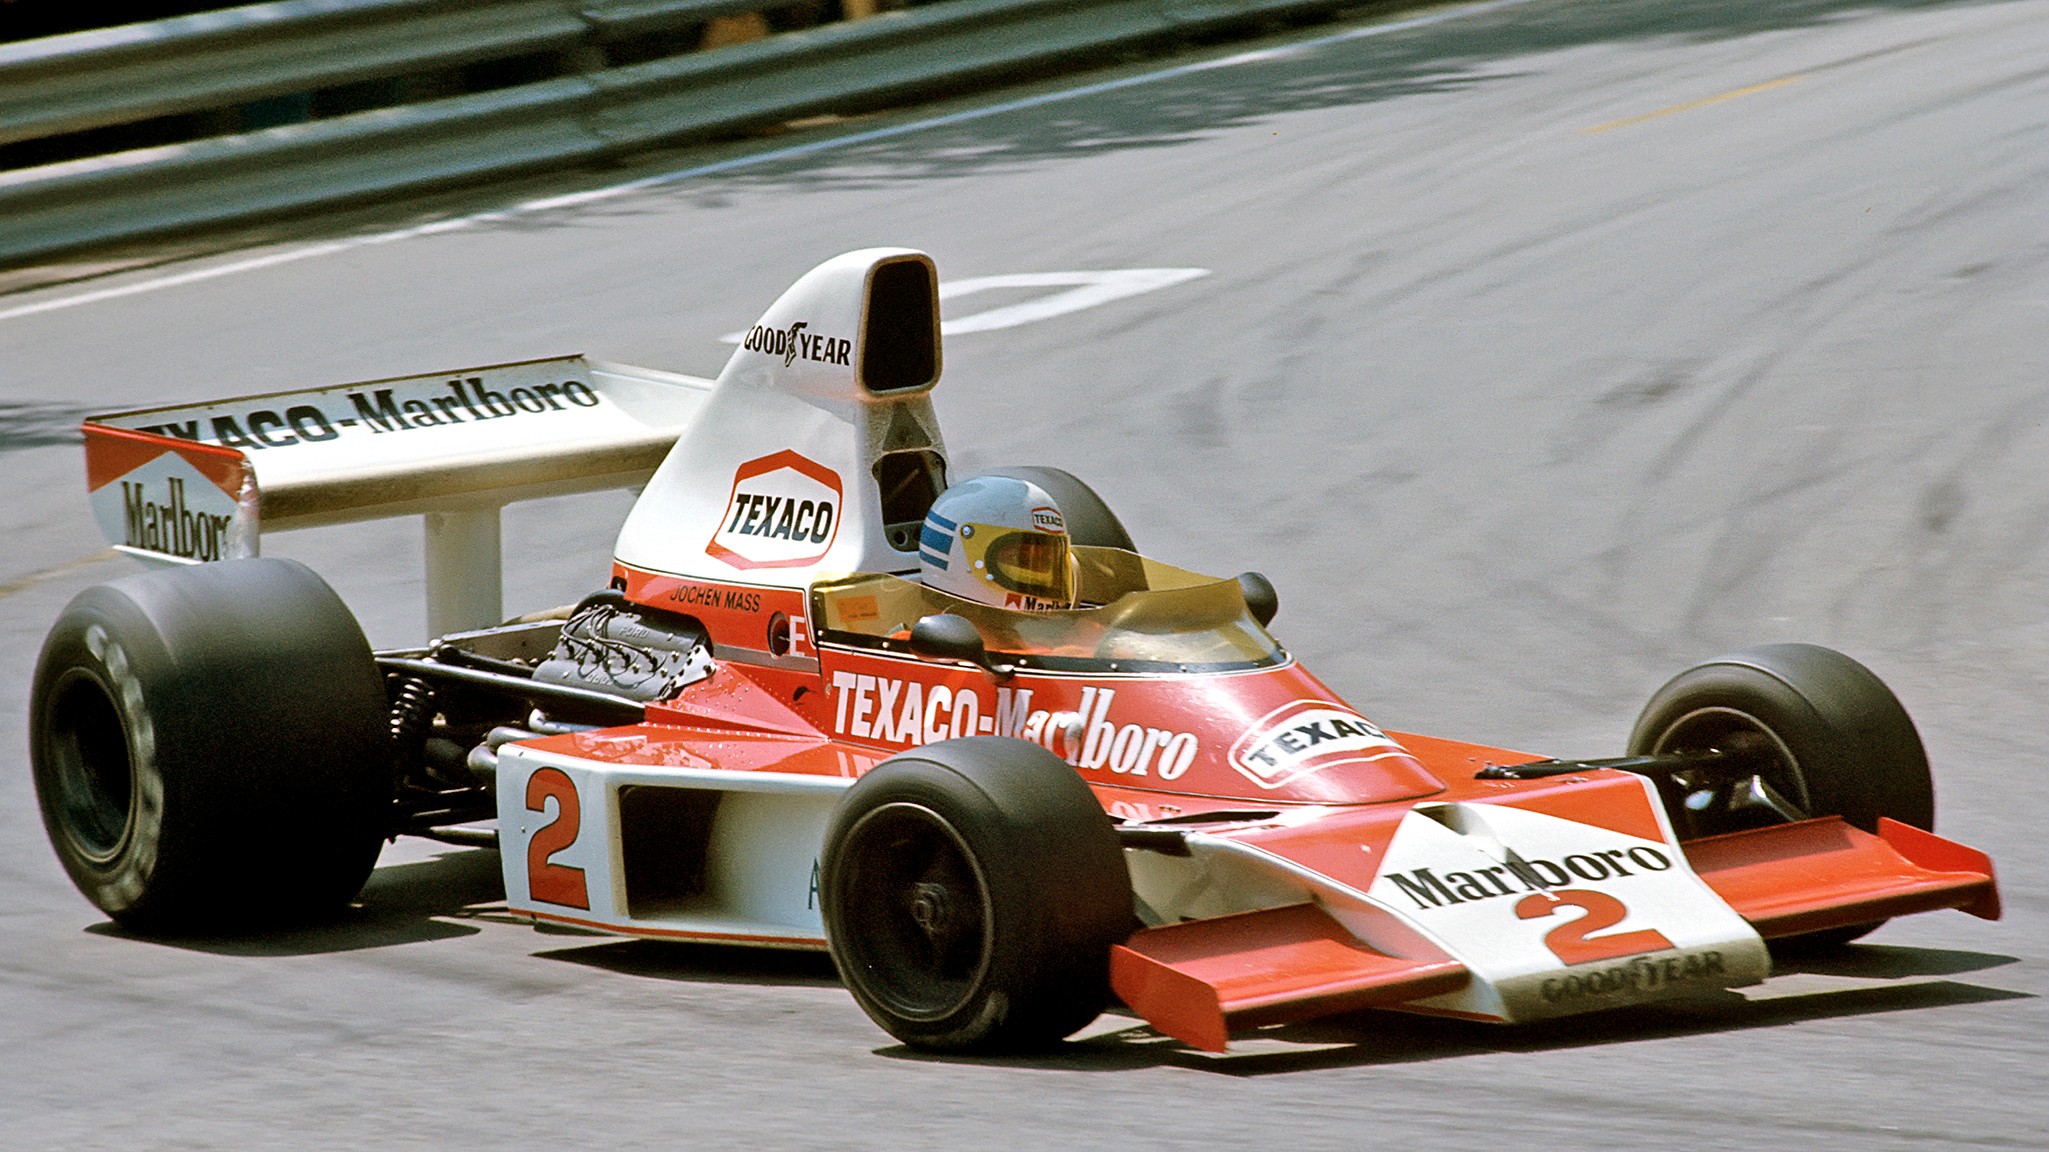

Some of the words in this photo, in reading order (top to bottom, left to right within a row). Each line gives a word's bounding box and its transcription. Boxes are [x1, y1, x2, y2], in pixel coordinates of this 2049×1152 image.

[743, 321, 851, 367] GOODYEAR
[121, 477, 232, 562] Marlbor
[727, 493, 834, 545] TEXACO
[670, 584, 722, 607] JOCHEN
[724, 591, 761, 613] MASS
[1248, 719, 1388, 767] TEXAC
[525, 766, 591, 912] 2
[1514, 889, 1676, 966] 2
[1540, 951, 1726, 1003] GOODYEAR
